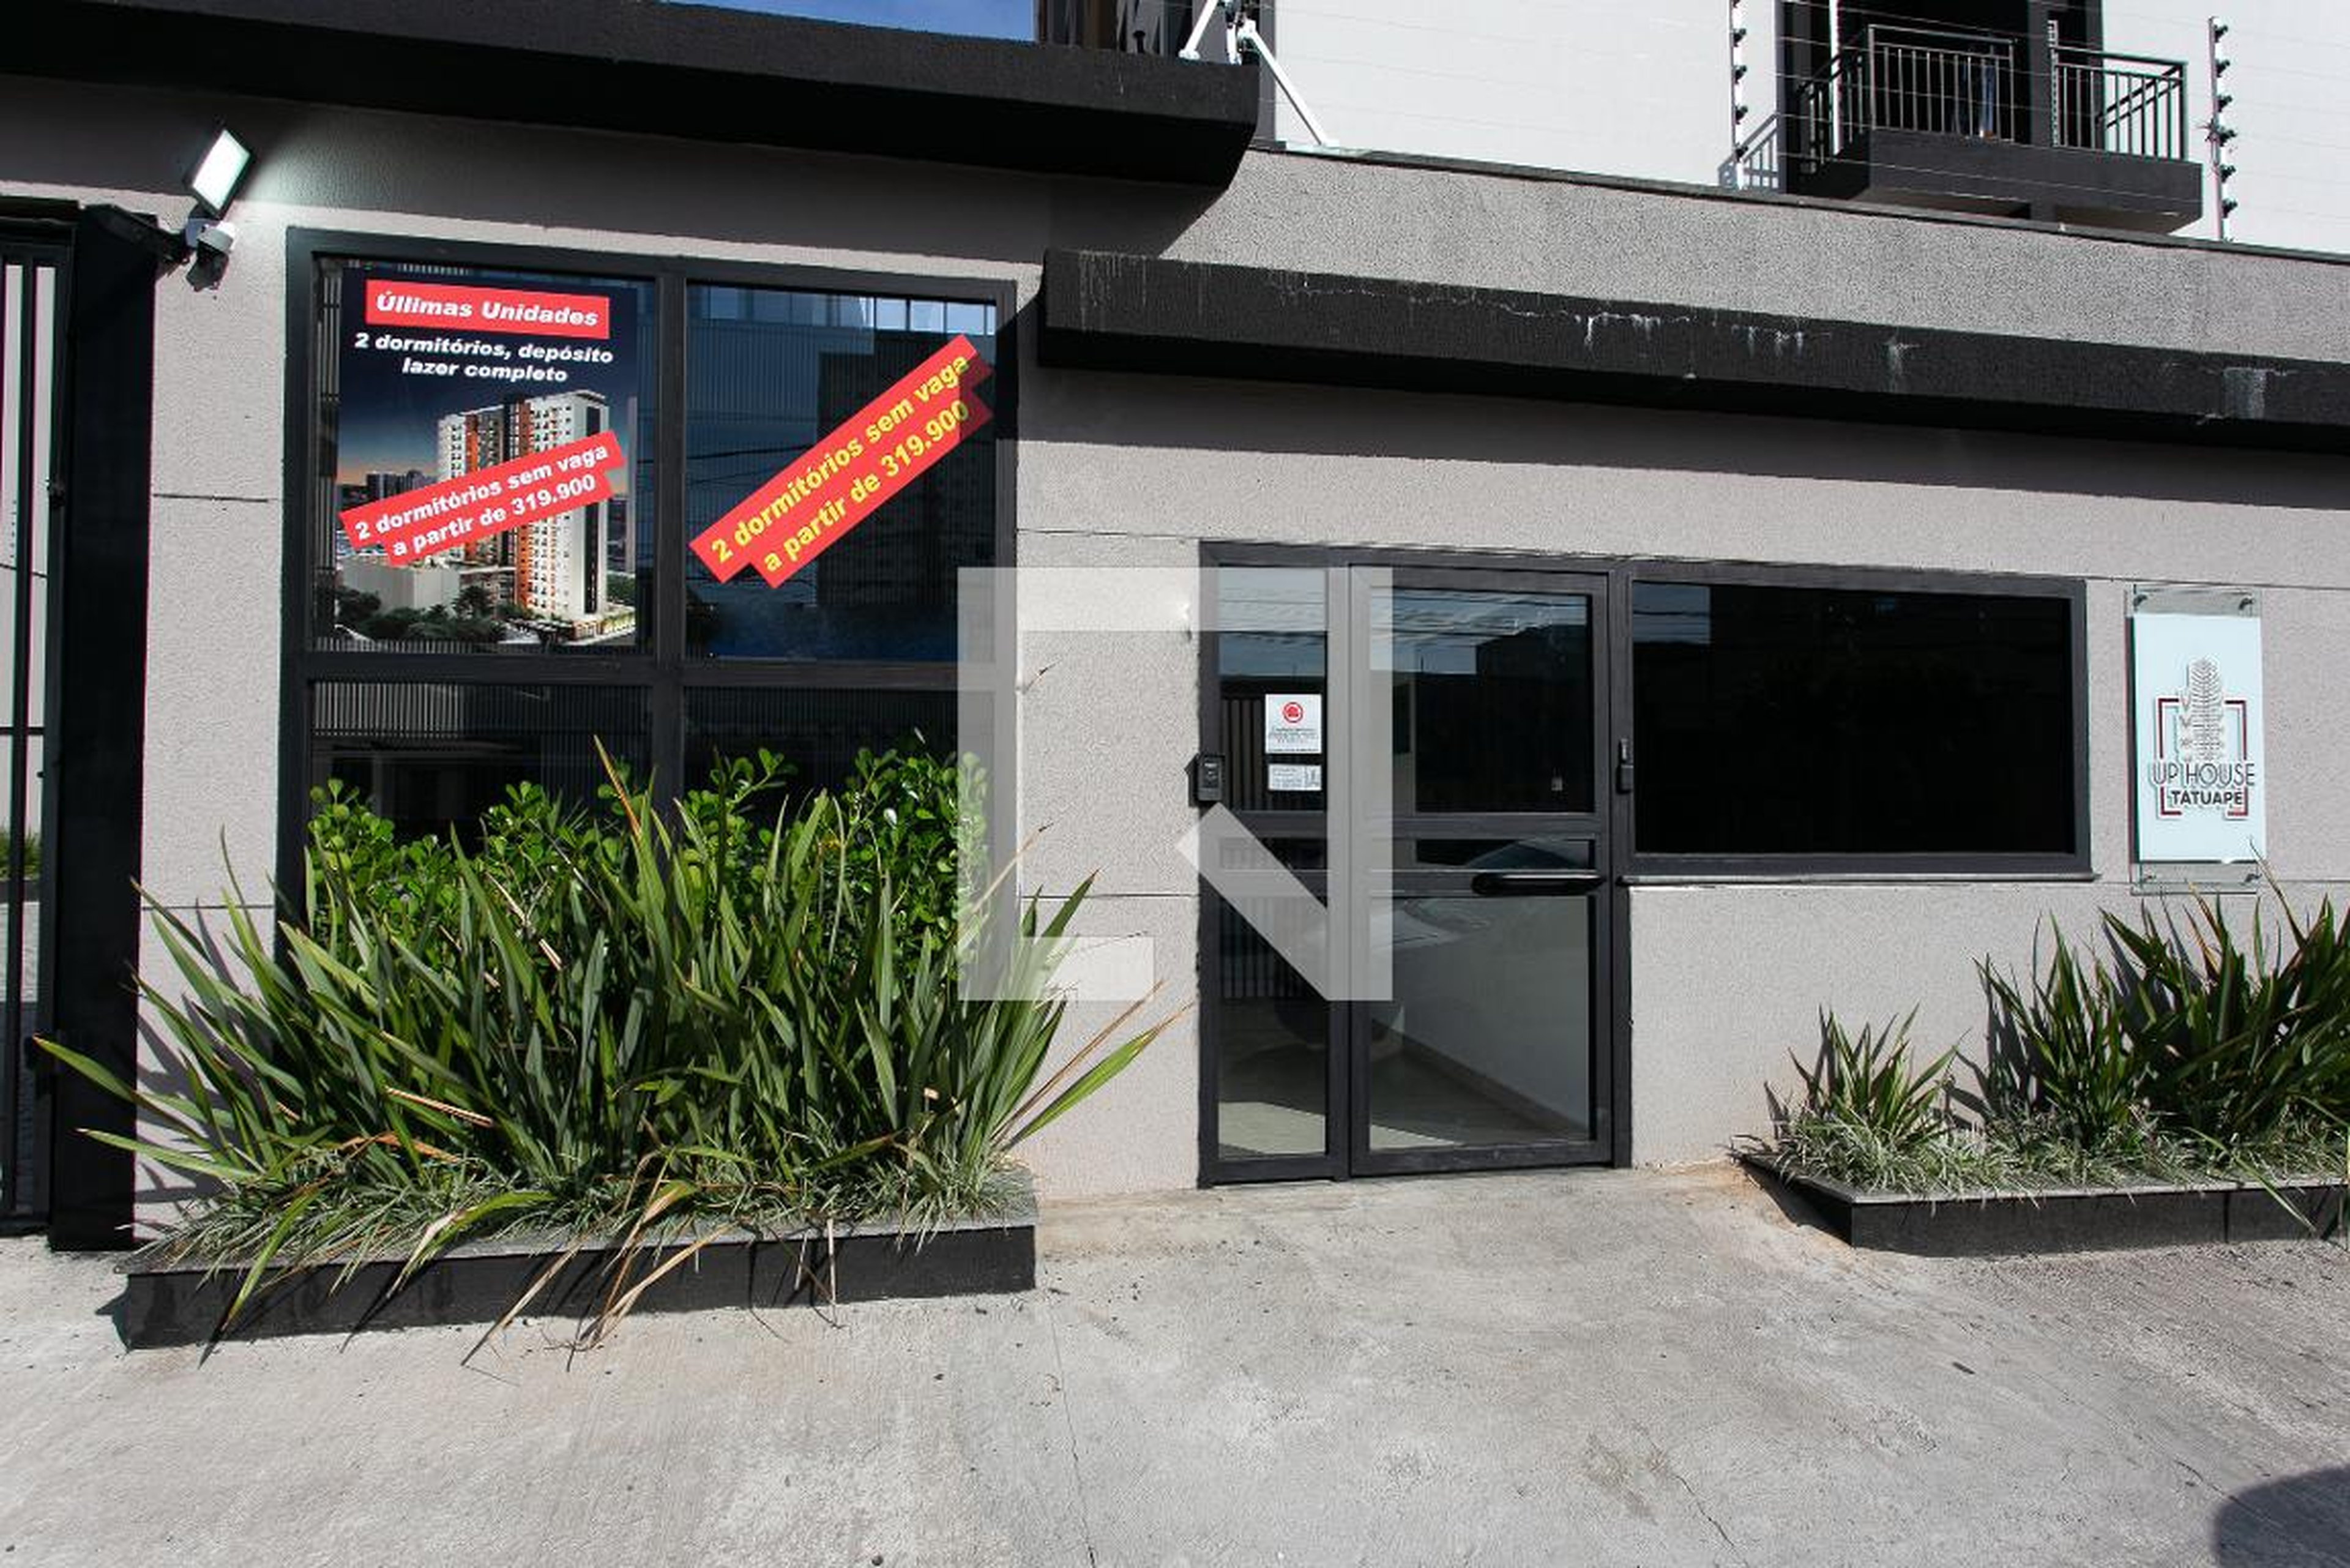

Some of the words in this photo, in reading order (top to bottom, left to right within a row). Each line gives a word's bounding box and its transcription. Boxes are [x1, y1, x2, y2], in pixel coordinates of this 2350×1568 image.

[481, 302, 599, 326] Unidades
[354, 332, 369, 349] 2
[375, 335, 511, 360] dormitórios,
[518, 343, 614, 363] depósito
[401, 357, 460, 376] lazer
[464, 365, 568, 383] completo
[711, 539, 733, 564] 2
[733, 438, 864, 547] dormitórios
[865, 397, 915, 444] sem
[914, 356, 970, 404] vaga
[763, 552, 782, 573] a
[783, 497, 849, 561] partir
[850, 472, 881, 503] de
[880, 400, 969, 478] 319.900
[355, 520, 371, 541] 2
[375, 481, 502, 534] dormitórios
[507, 464, 553, 490] sem
[557, 446, 608, 472] vaga
[392, 541, 408, 556] a
[412, 517, 474, 554] partir
[480, 507, 507, 526] de
[511, 474, 595, 516] 319.900
[2153, 763, 2179, 785] UP
[2186, 763, 2255, 786] HOUSE
